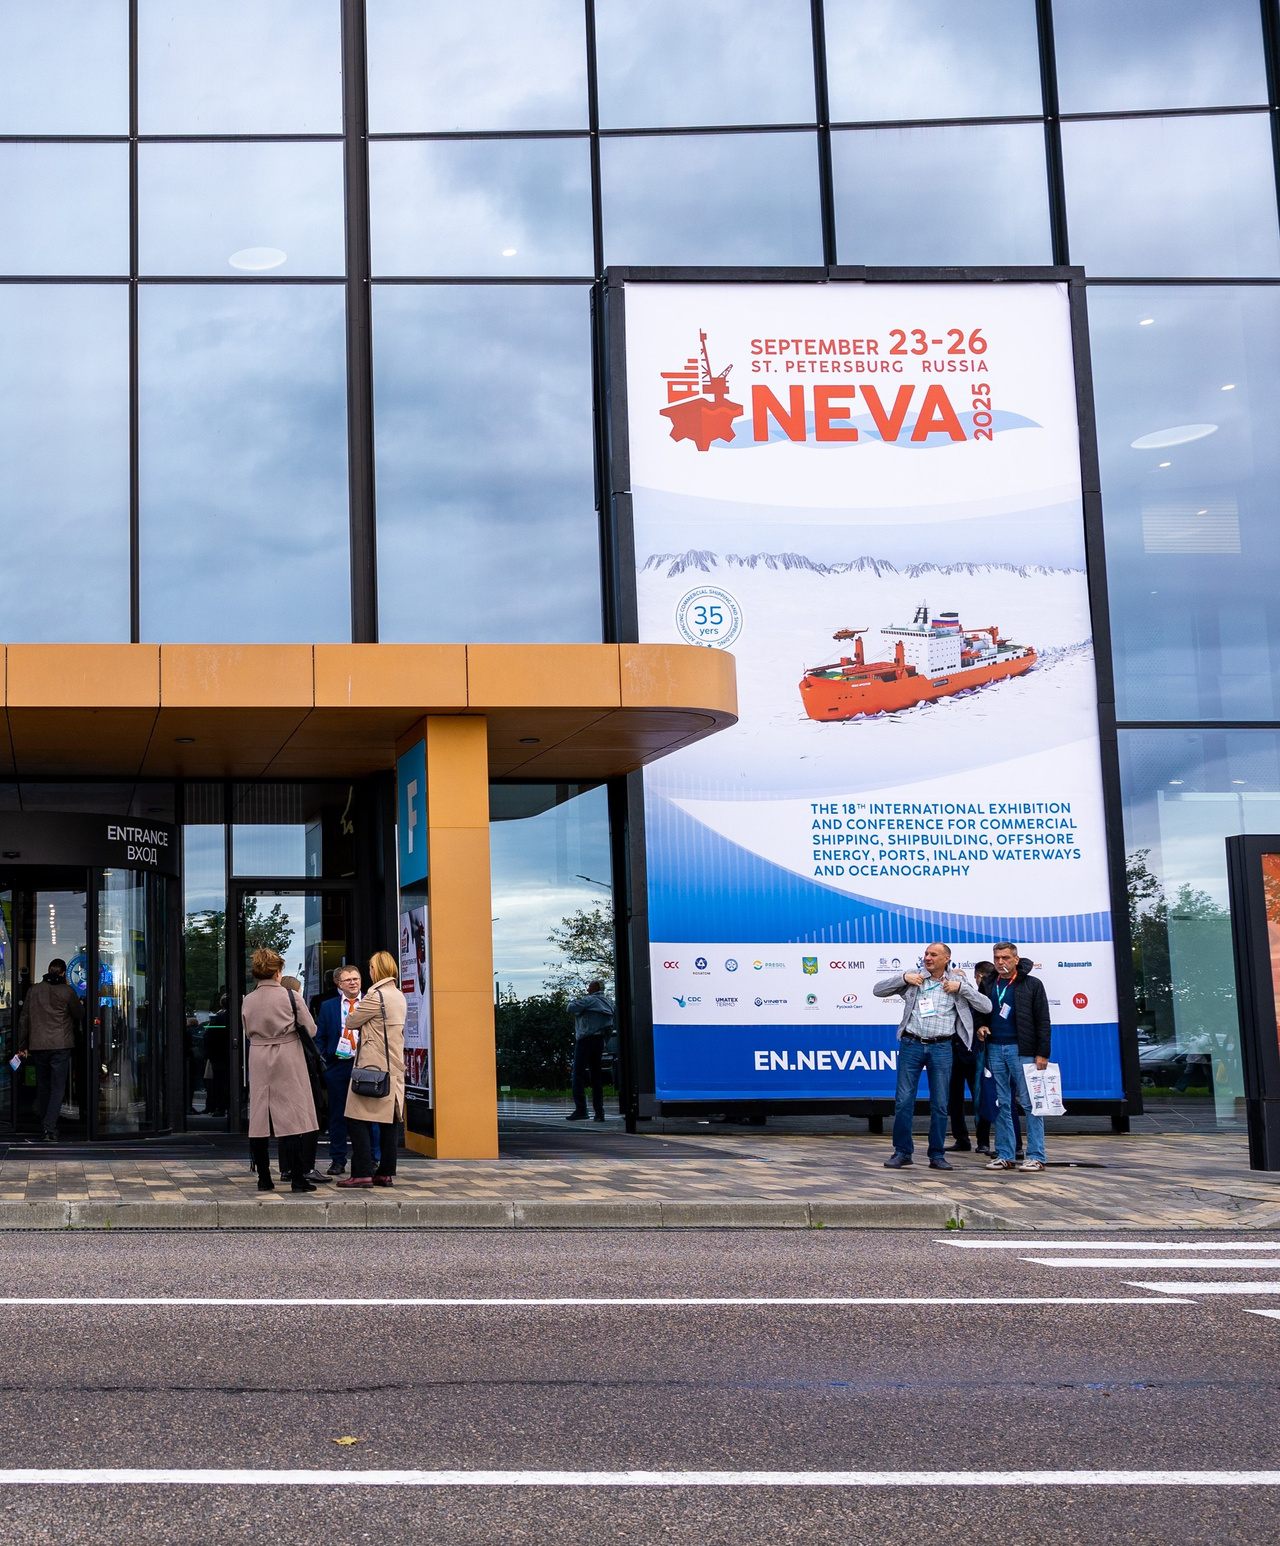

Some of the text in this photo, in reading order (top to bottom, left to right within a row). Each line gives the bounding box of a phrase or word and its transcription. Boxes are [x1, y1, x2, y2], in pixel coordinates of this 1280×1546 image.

[750, 328, 988, 356] SEPTEMBER 23-26
[751, 360, 989, 373] ST. PETERSBURG RUSSIA
[751, 384, 968, 442] NEVA
[971, 382, 993, 441] 2025
[694, 606, 723, 625] 35
[699, 628, 719, 636] yers
[811, 803, 839, 815] THE
[869, 803, 985, 815] INTERNATIONAL
[989, 802, 1071, 814] EXHIBITION
[407, 778, 418, 853] F
[811, 818, 1077, 830] AND CONFERENCE FOR COMMERCIAL
[107, 825, 168, 847] ENTRANCE
[812, 833, 1074, 846] SHIPPING, SHIPBUILDING, OFFSHORE
[127, 845, 158, 866] ВХОД
[813, 848, 1081, 862] ENERGY, PORTS, INLAND WATERWAYS
[814, 865, 970, 876] AND OCEANOGRAPHY
[663, 961, 680, 969] ОСК
[829, 961, 865, 969] ОСК КМП
